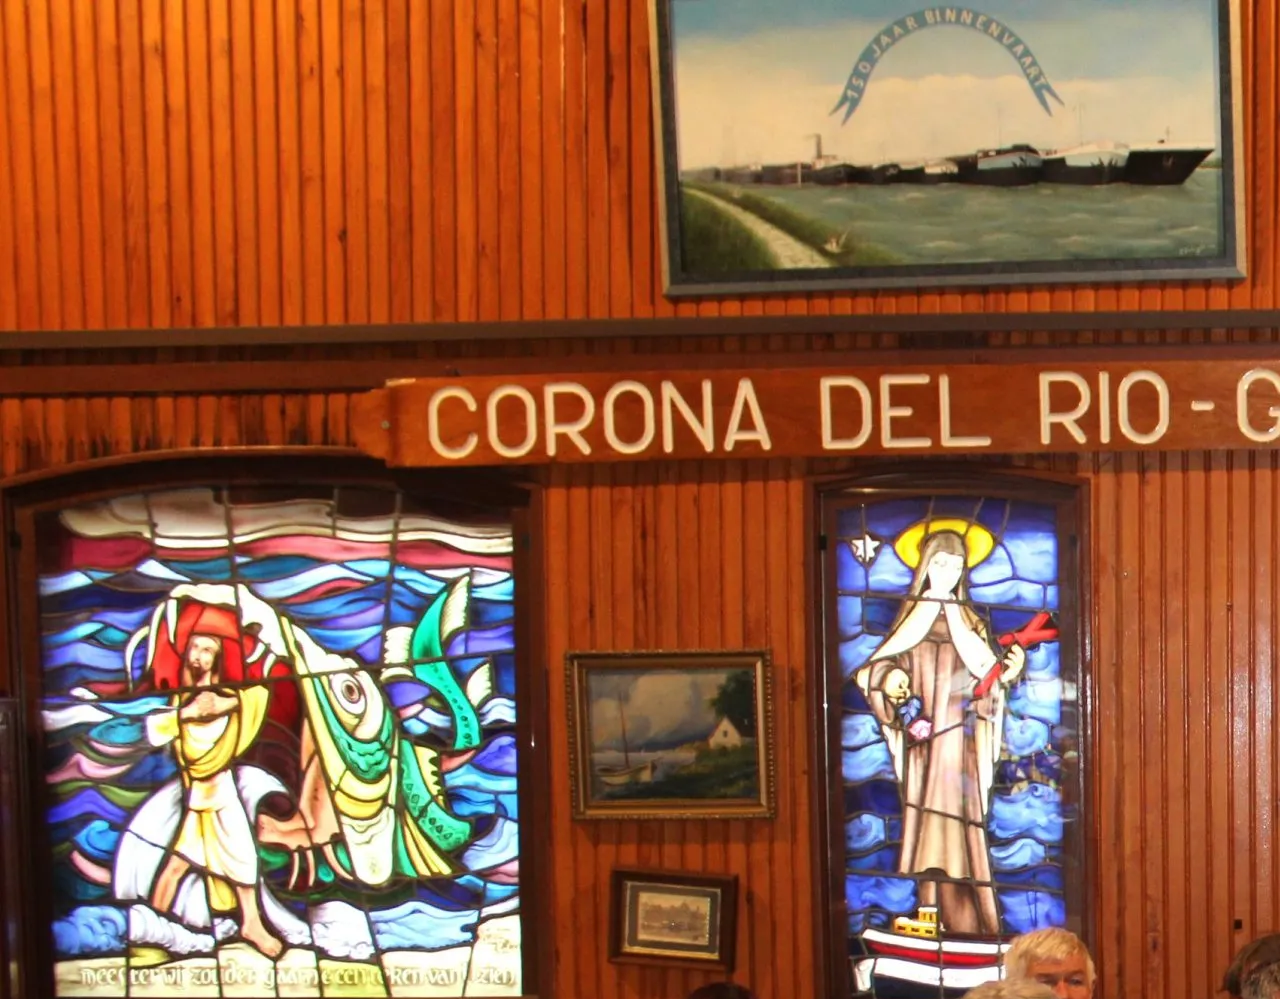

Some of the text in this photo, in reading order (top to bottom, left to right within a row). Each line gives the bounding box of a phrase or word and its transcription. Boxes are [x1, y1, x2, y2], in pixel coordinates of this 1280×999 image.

[846, 7, 1047, 99] 150 JAAR BINNENVAART
[427, 377, 772, 459] CORONA
[820, 373, 992, 450] DEL
[1039, 370, 1169, 445] RIO
